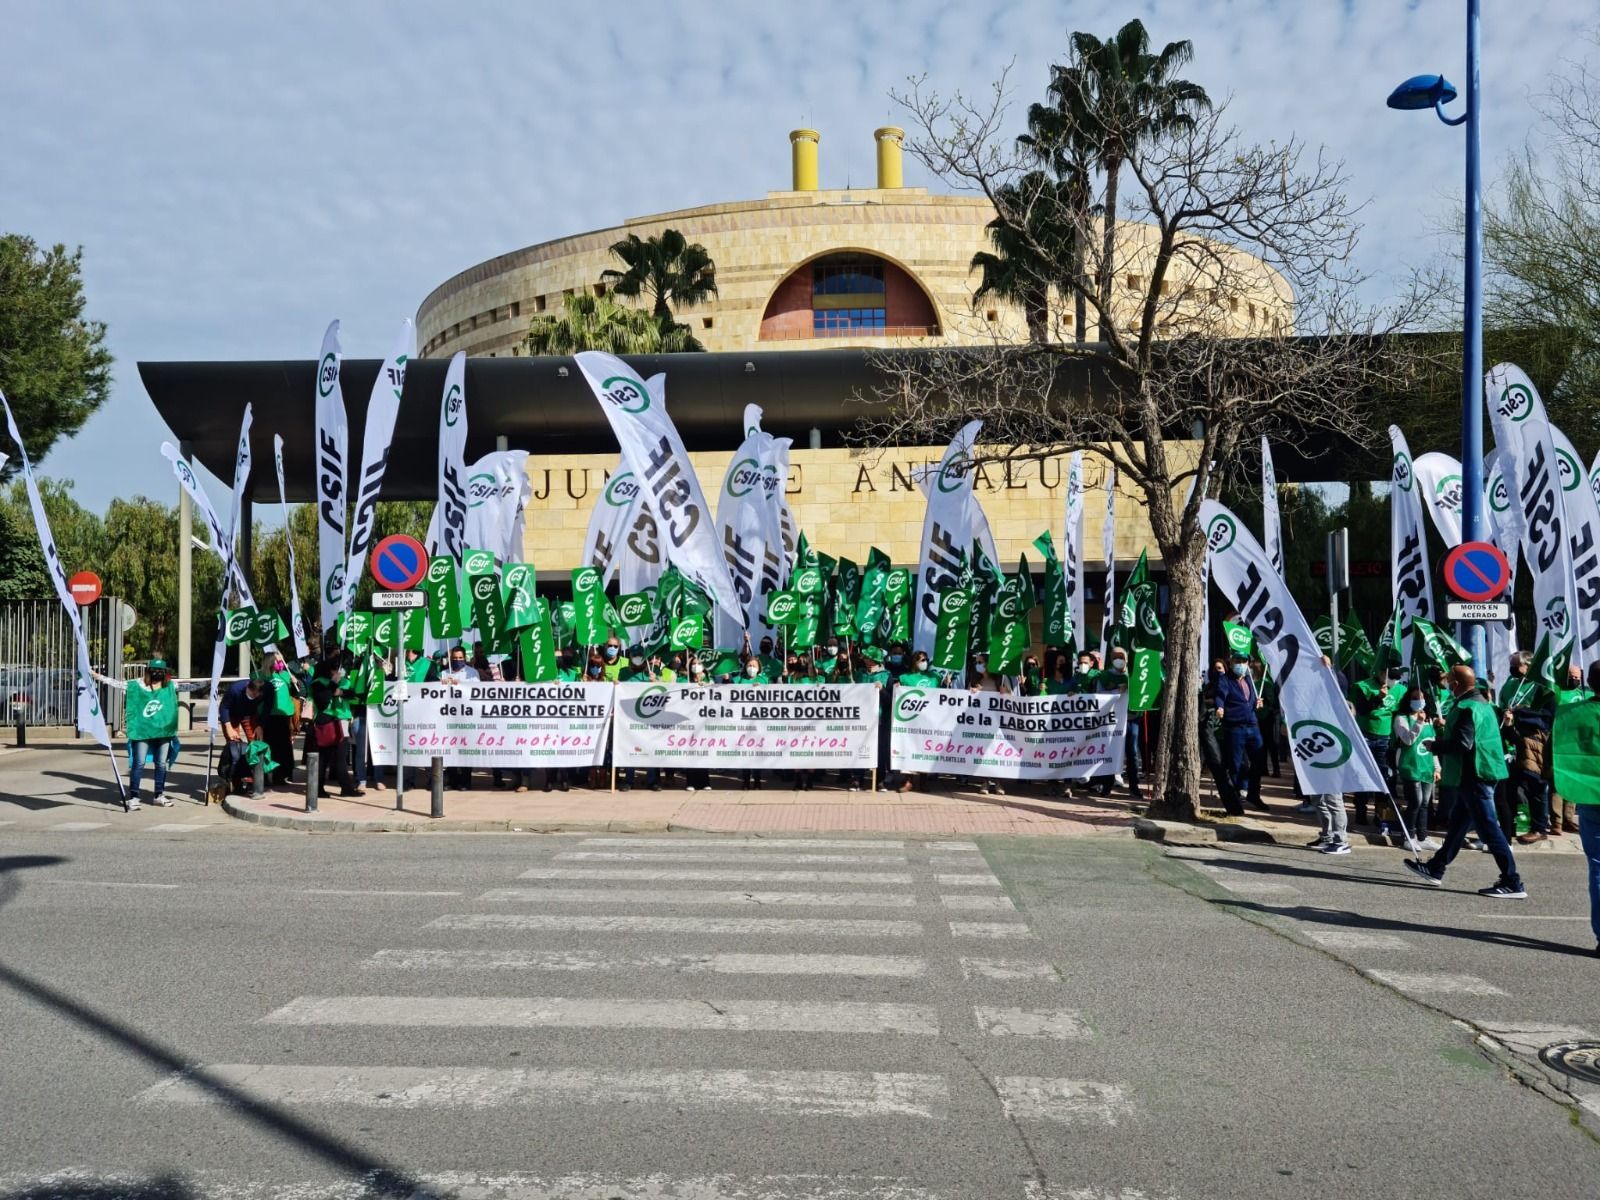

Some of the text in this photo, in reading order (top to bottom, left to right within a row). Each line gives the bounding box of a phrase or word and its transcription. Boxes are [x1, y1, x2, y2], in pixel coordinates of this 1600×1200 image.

[320, 428, 343, 535] CSIF
[763, 477, 781, 491] SIF
[431, 564, 451, 575] CSIF
[470, 559, 490, 569] CSIF
[580, 575, 599, 585] CSIF
[802, 577, 820, 586] CSIF
[888, 576, 906, 585] CSIF
[479, 584, 496, 593] CSIF
[774, 601, 797, 612] CSIF
[947, 597, 968, 607] CSIF
[626, 604, 646, 615] CSIF
[231, 617, 253, 632] CSIF
[677, 626, 699, 638] CSIF
[1233, 633, 1251, 644] CSIF
[420, 684, 586, 700] Por la DIGNIFICACIÓN
[681, 686, 841, 701] Por la DIGNIFICACIÓN
[642, 695, 672, 708] CSIF
[900, 698, 930, 712] CSIF
[939, 694, 1100, 713] Por la DIGNIFICACIÓN
[440, 704, 605, 717] de la LABOR DOCENTE
[699, 706, 860, 718] de la LABOR DOCENTE
[956, 711, 1117, 731] de la LABOR DOCENTE
[408, 731, 591, 746] Sobran los motivos
[667, 733, 848, 748] Sobran los motivos
[924, 739, 1106, 760] Sobran los motivos
